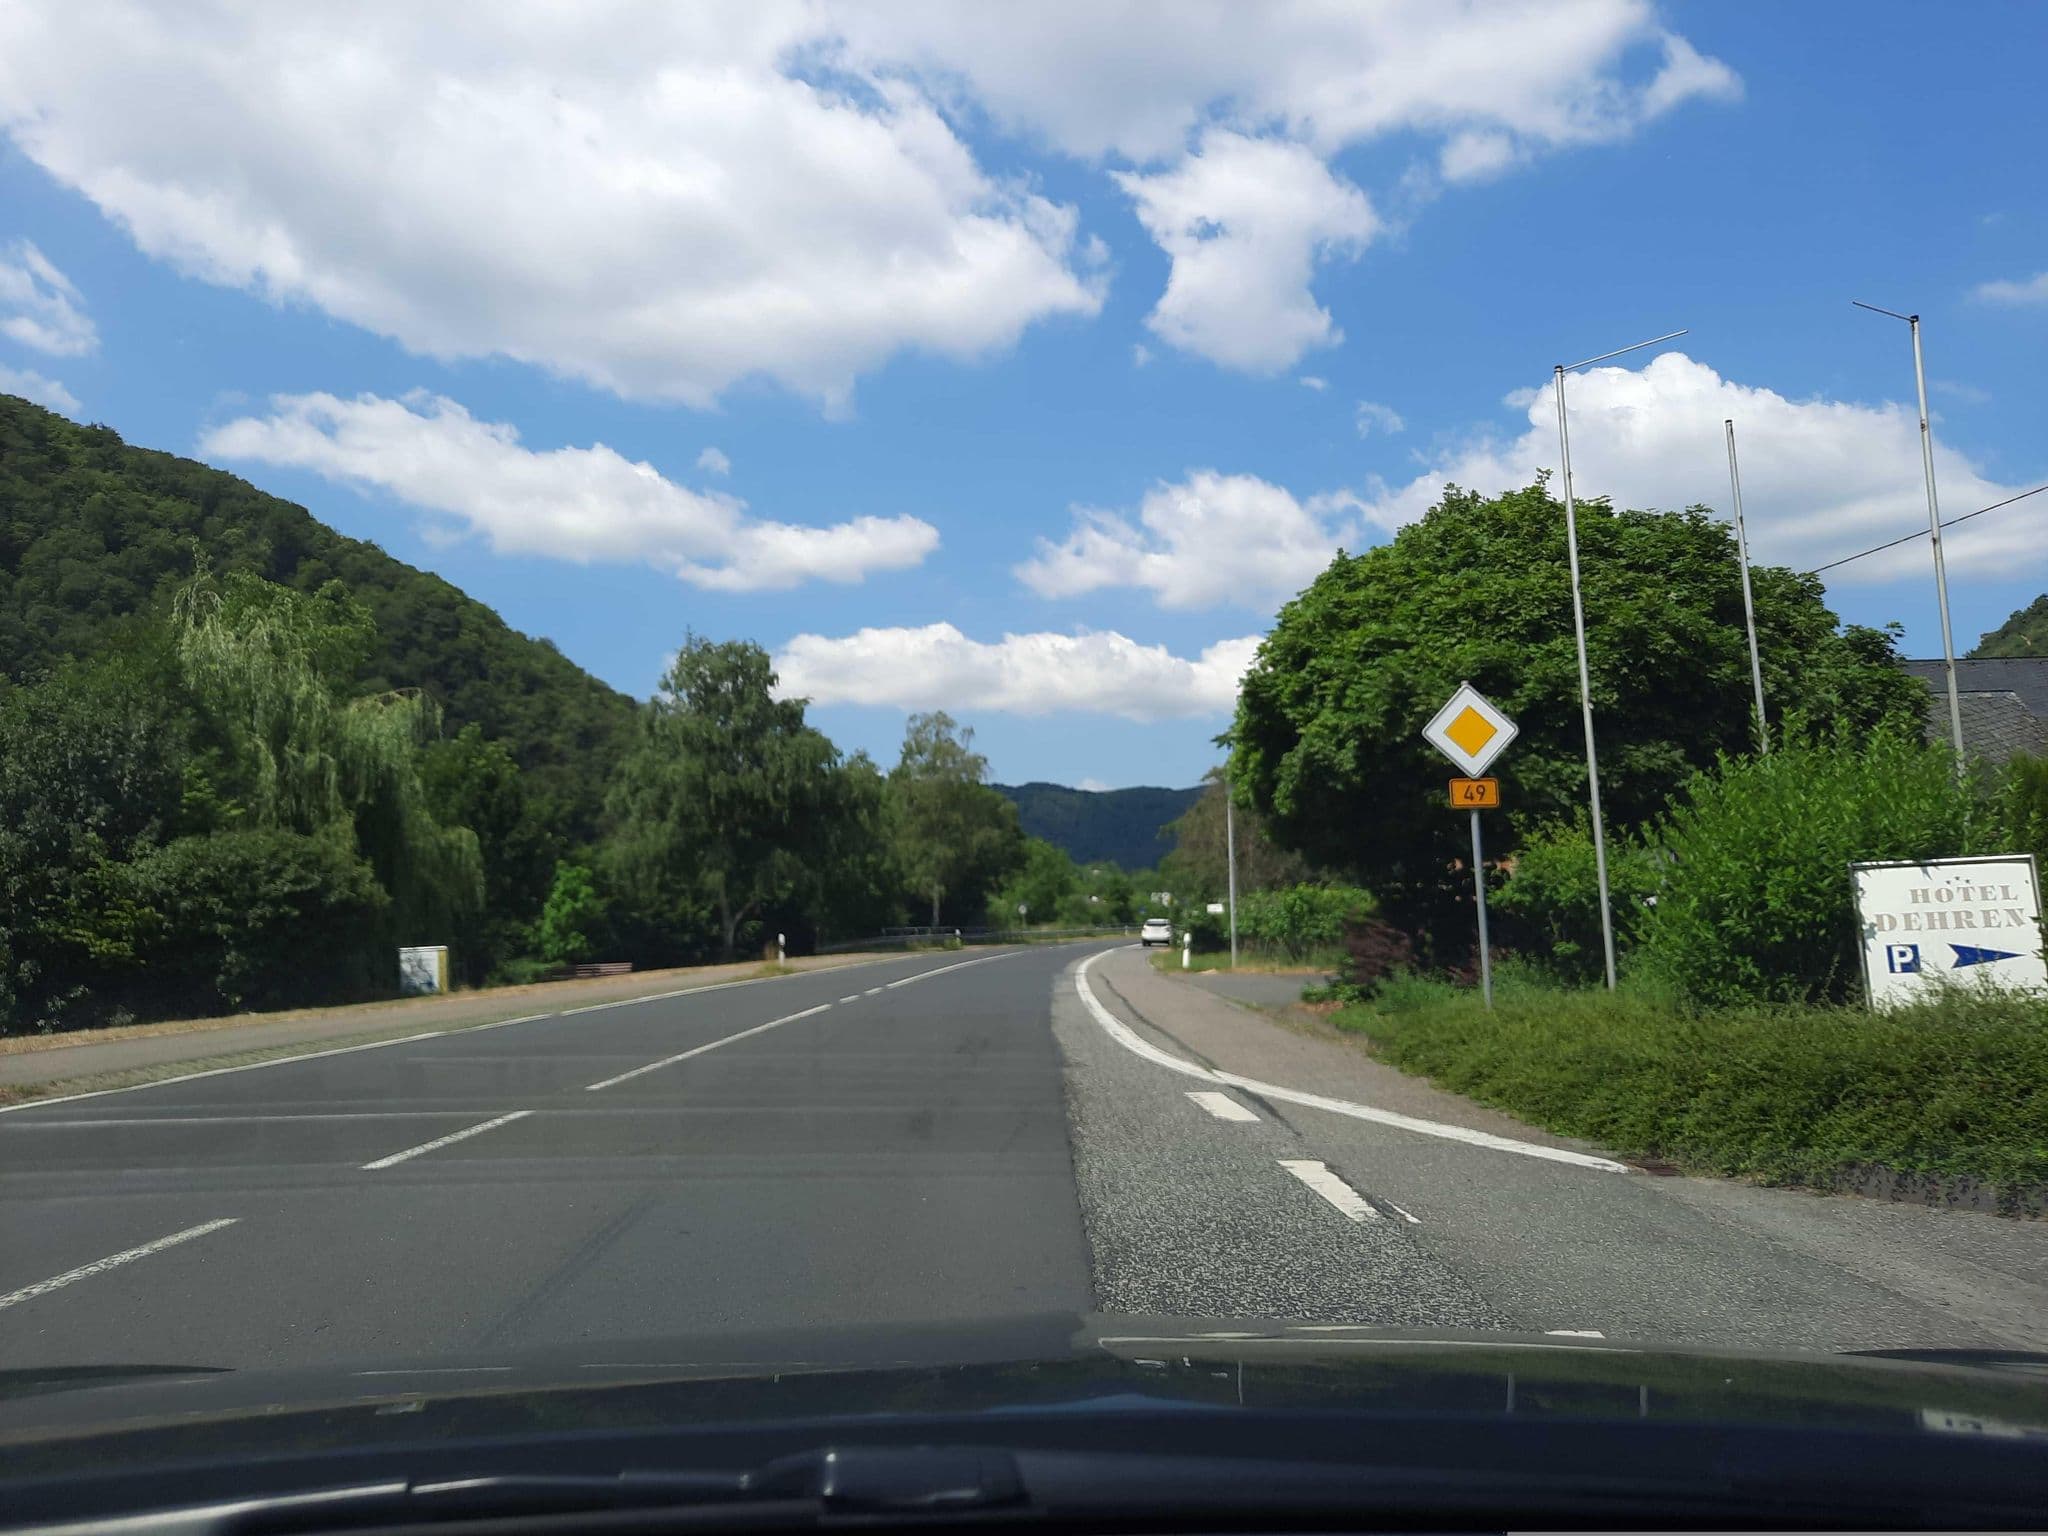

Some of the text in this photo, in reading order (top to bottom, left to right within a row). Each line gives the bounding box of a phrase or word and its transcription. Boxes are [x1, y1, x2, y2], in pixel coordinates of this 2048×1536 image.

[1464, 784, 1486, 801] 49
[1909, 884, 2019, 904] HOTEL
[1874, 908, 2026, 932] DEHREN
[1891, 945, 1914, 973] P
